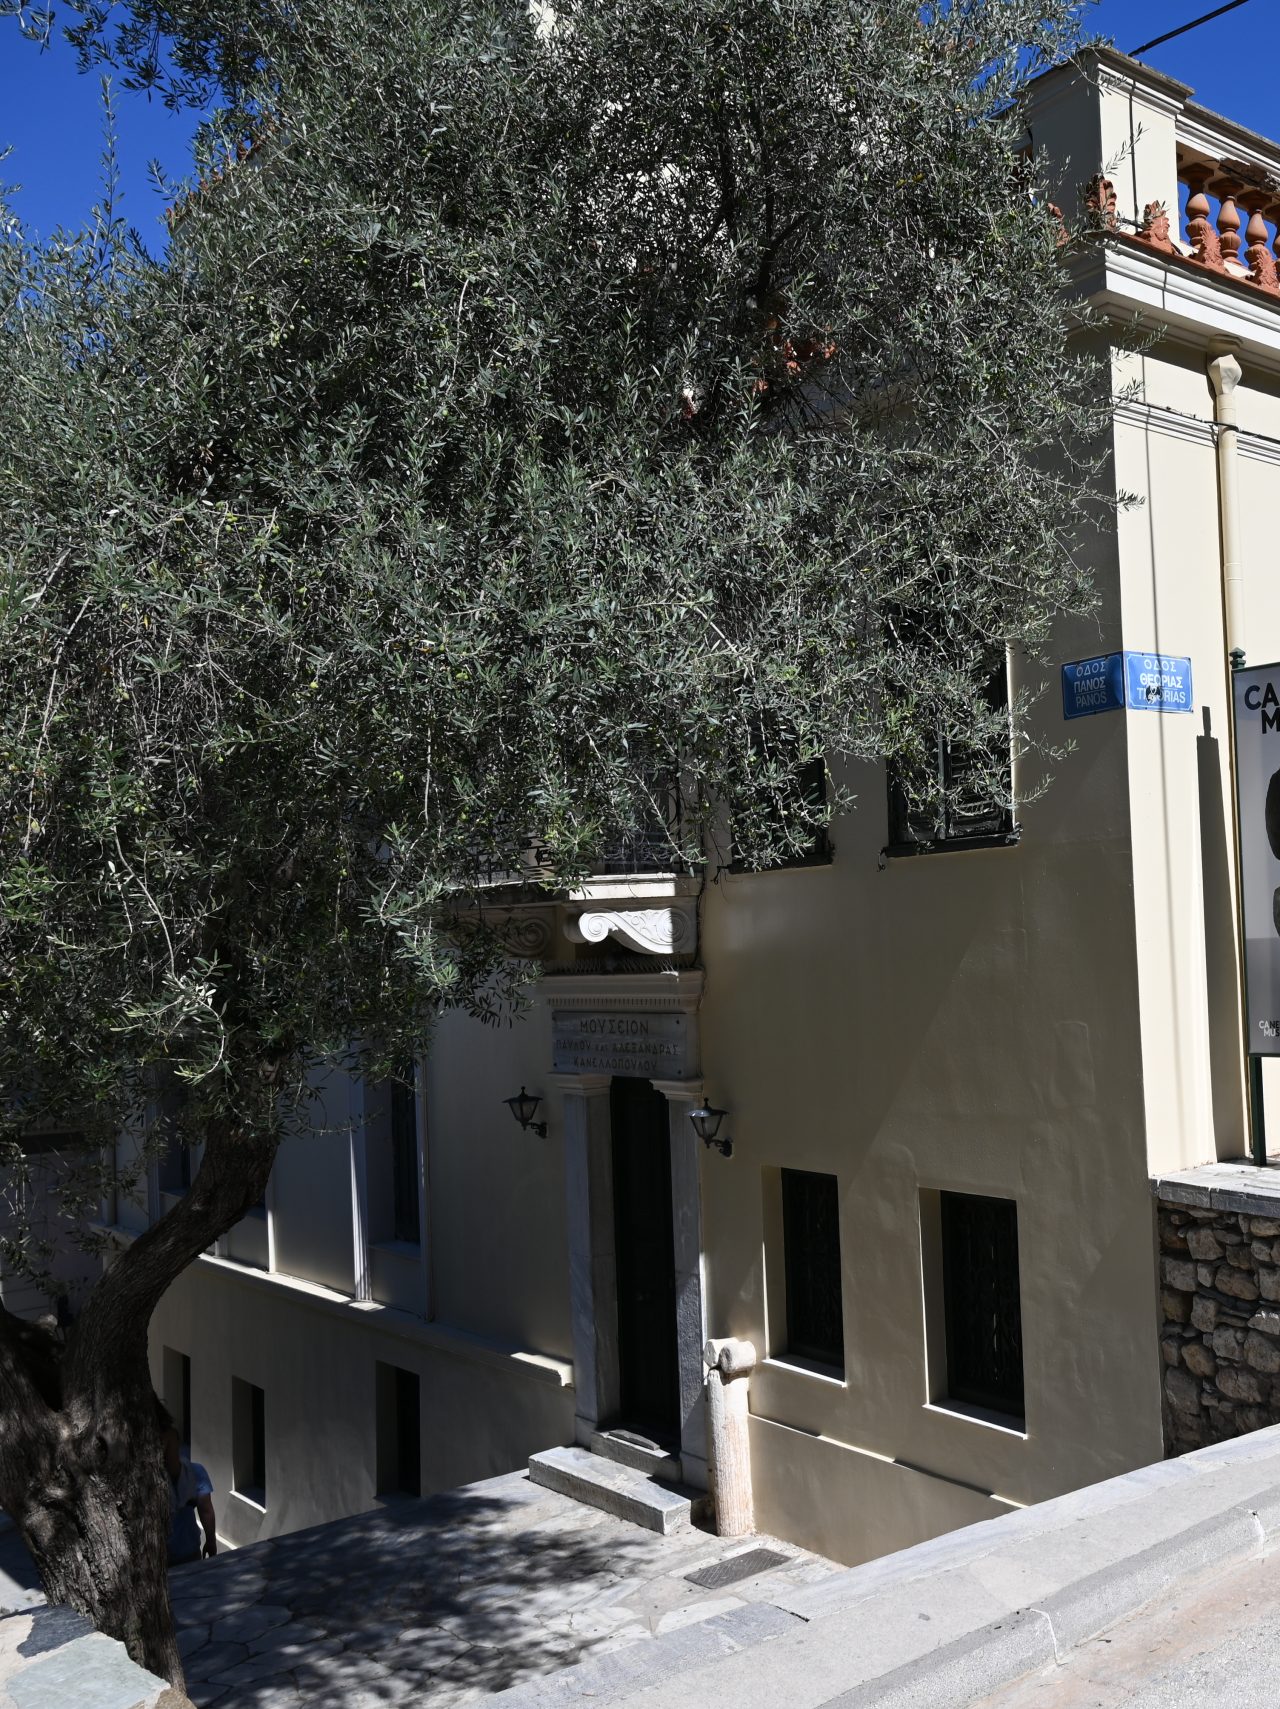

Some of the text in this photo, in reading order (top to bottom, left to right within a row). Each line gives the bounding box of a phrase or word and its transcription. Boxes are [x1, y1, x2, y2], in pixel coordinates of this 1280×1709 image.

[1076, 661, 1106, 677] ΟΔΟΣ
[1143, 658, 1177, 673] ΟΔΟΣ
[1073, 676, 1106, 693] ΠΑΝΟΣ
[1075, 691, 1107, 708] PANOS
[1244, 682, 1280, 710] CA
